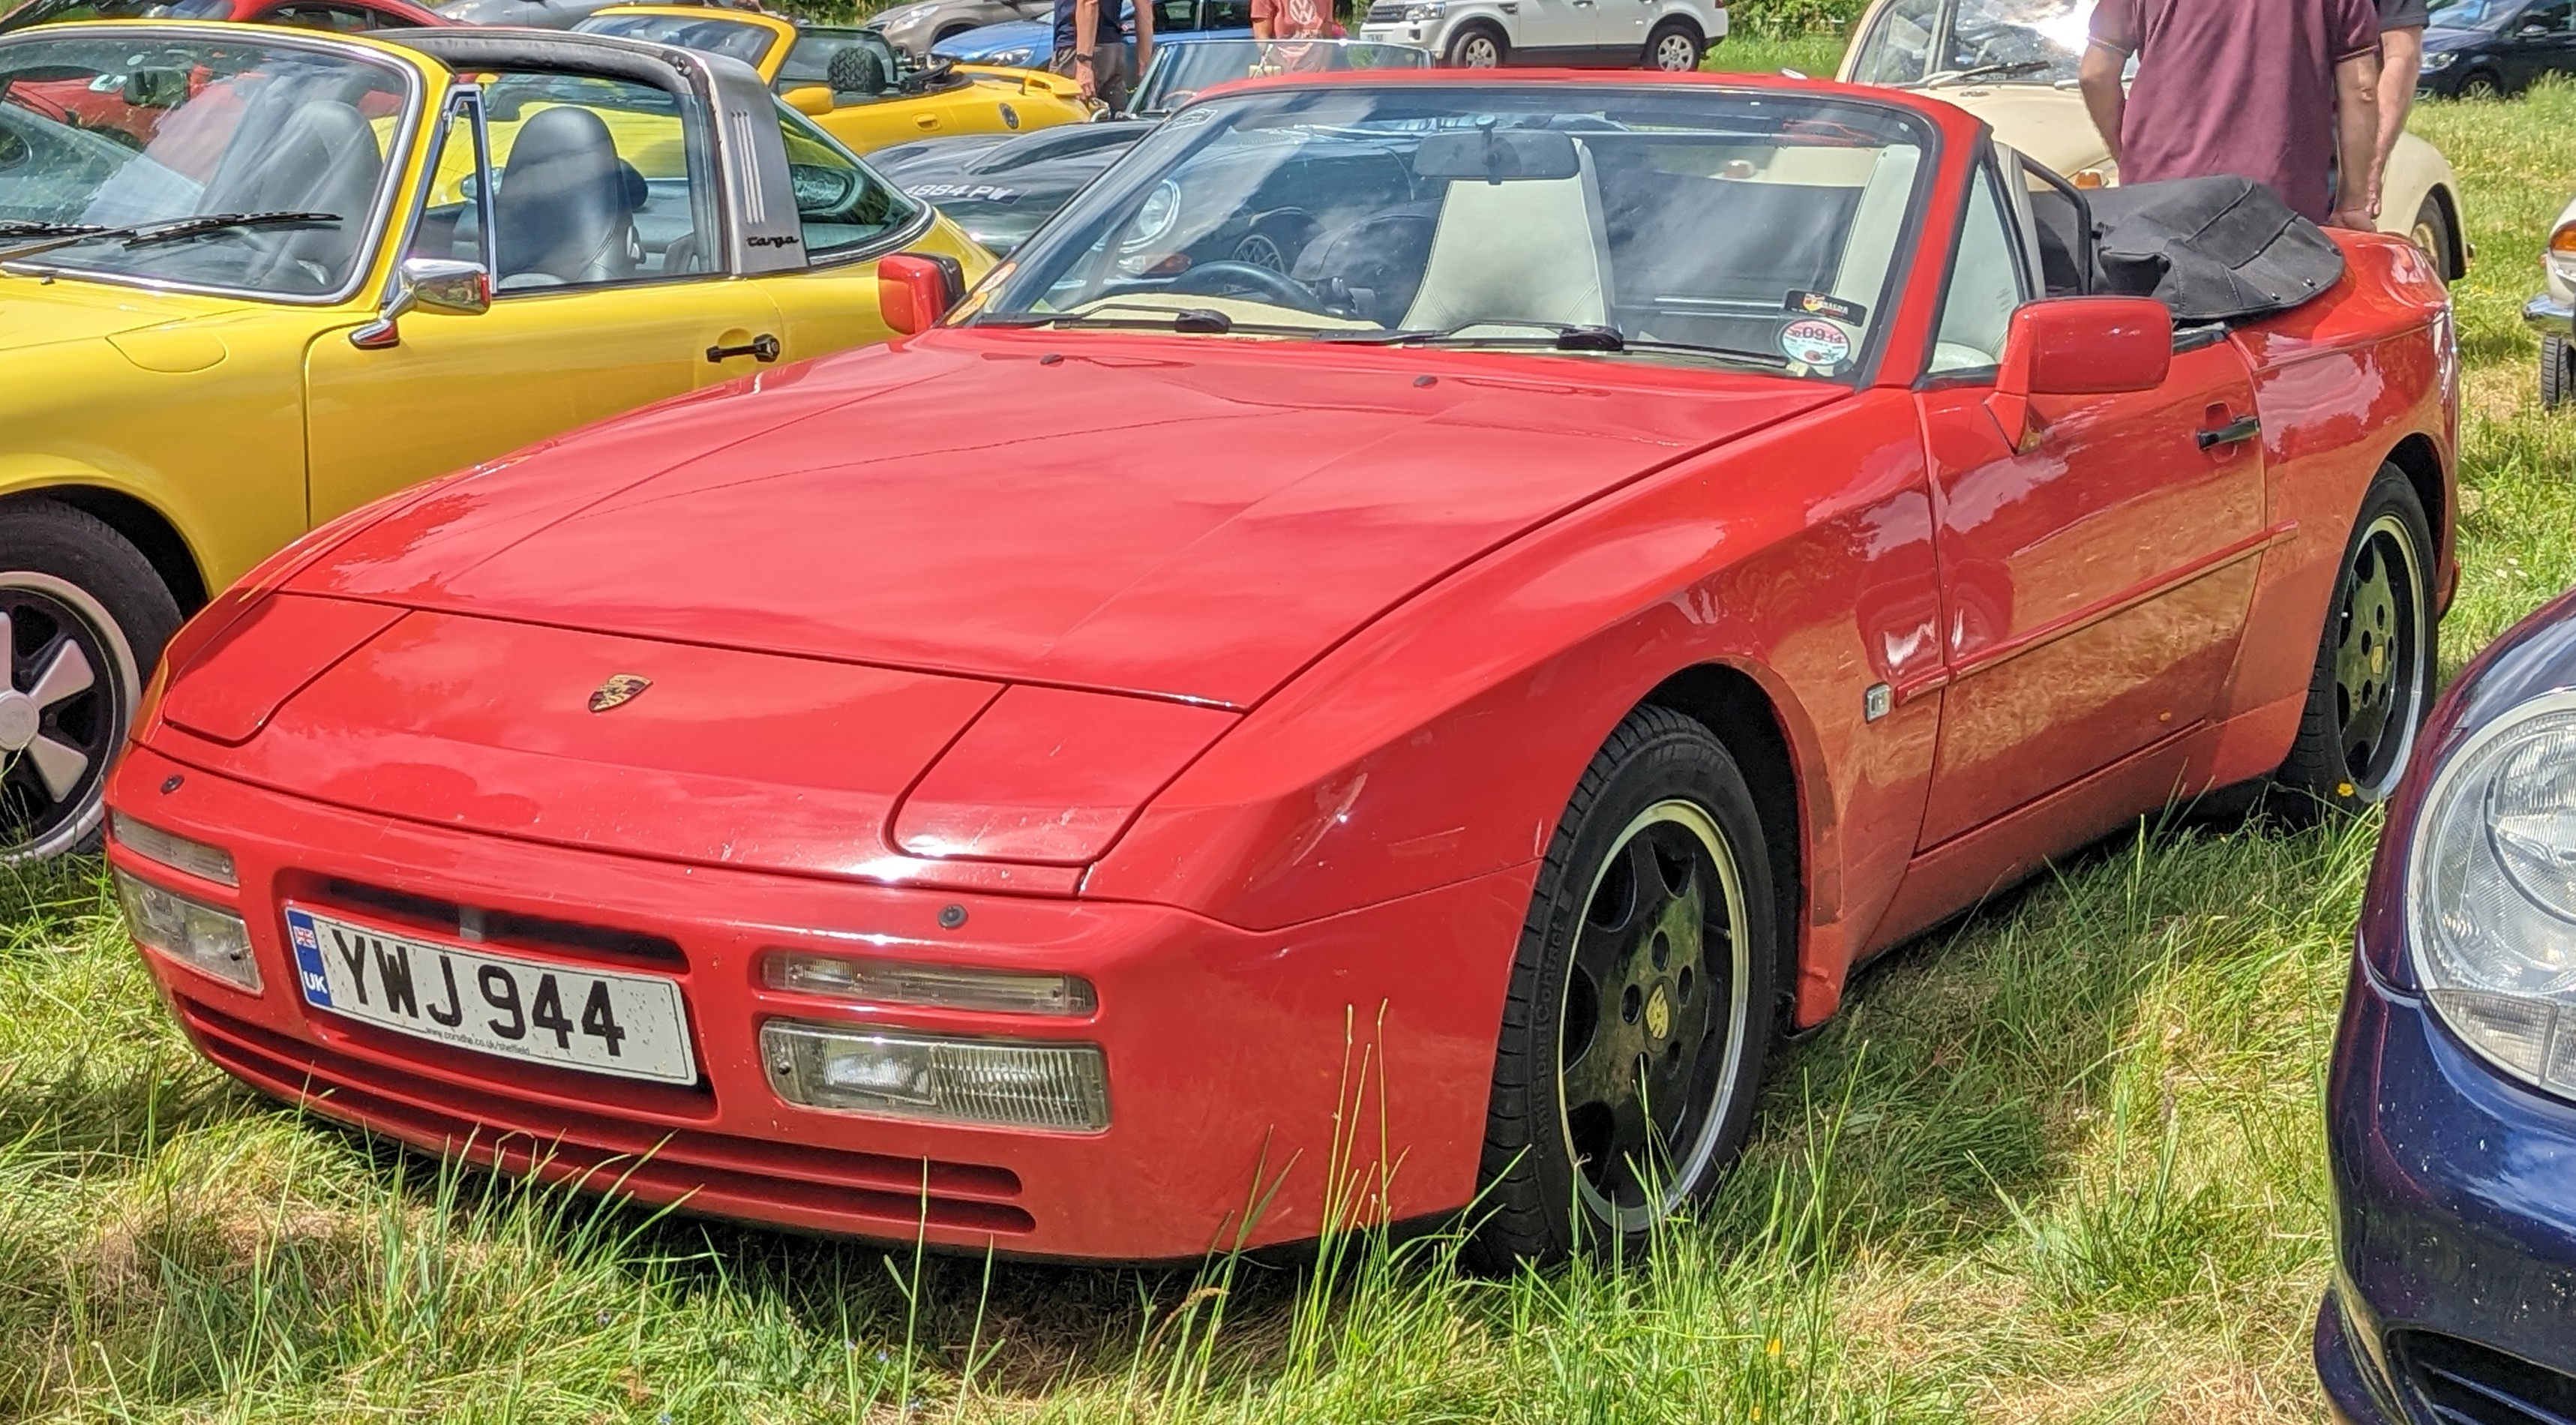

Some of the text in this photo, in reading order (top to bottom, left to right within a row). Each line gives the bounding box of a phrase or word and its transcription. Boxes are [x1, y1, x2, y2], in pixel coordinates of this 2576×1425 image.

[967, 184, 1014, 200] PW
[1803, 326, 1825, 340] 09
[302, 970, 328, 994] UK
[331, 928, 627, 1058] YWJ 944
